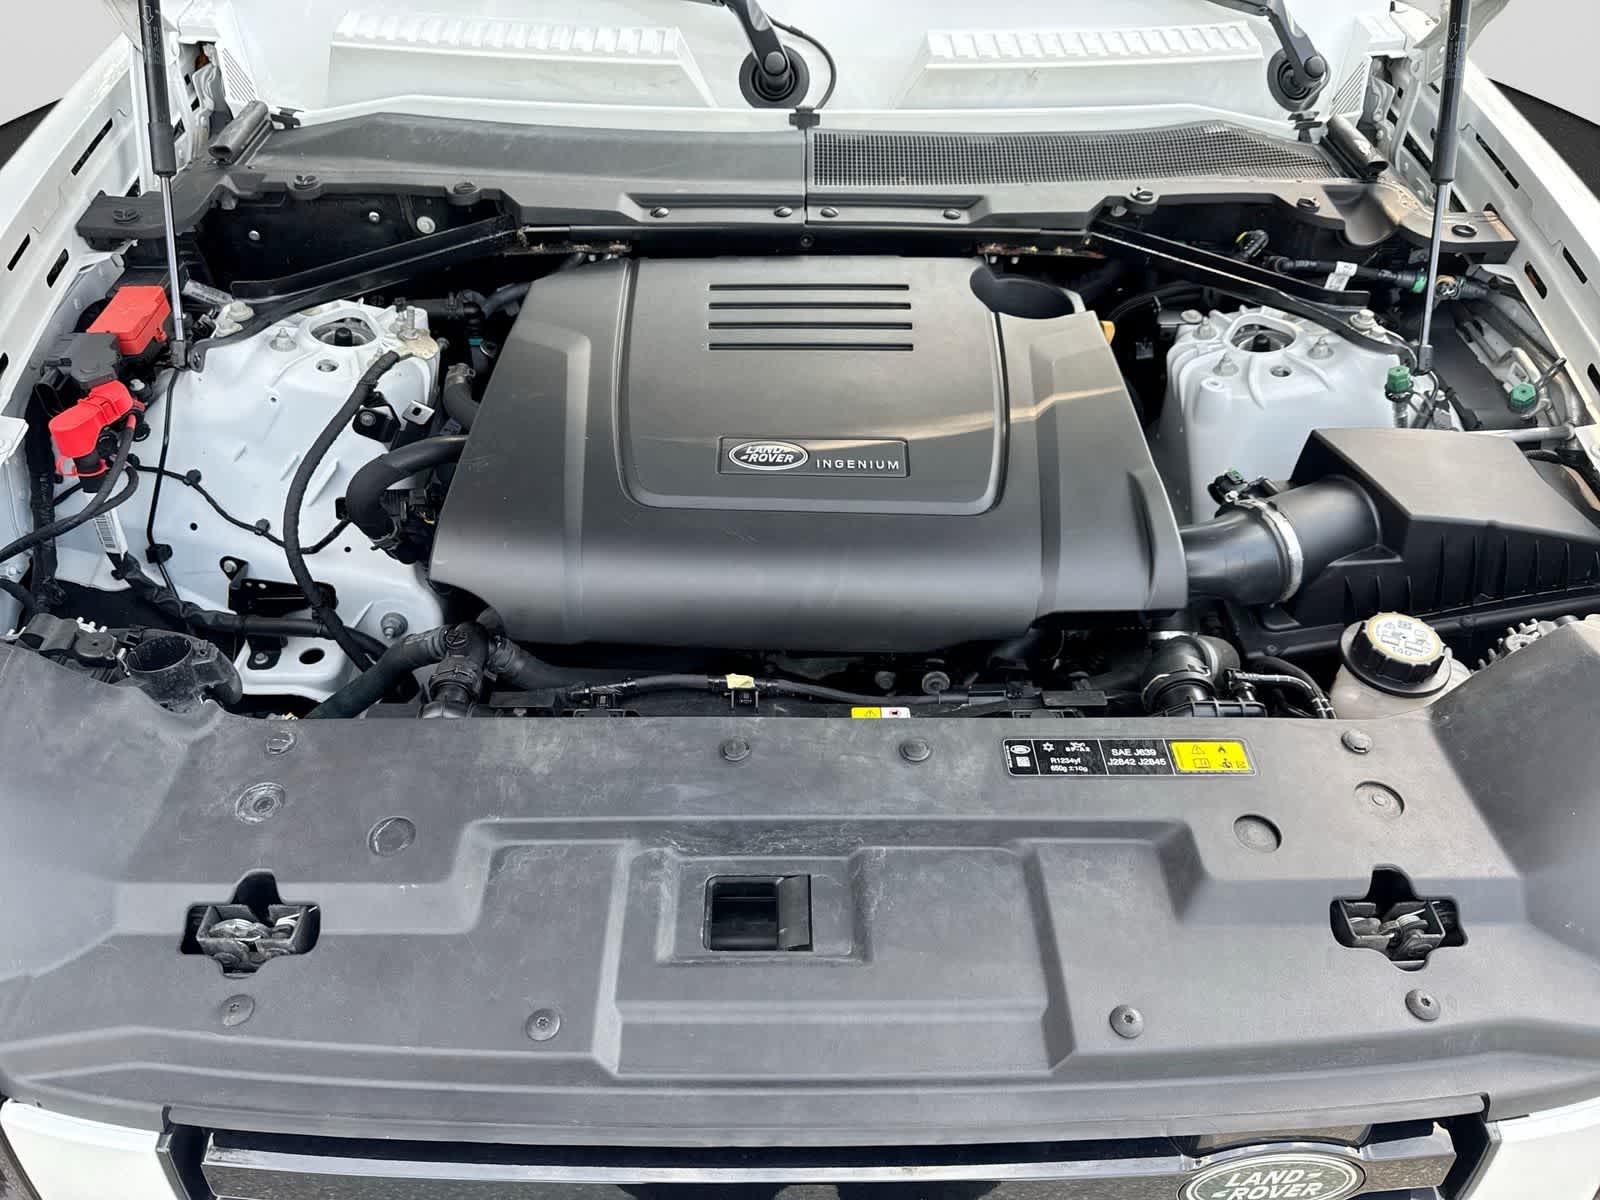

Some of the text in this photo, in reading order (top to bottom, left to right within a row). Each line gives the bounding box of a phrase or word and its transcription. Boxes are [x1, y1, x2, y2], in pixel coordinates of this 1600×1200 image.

[745, 446, 784, 454] LAND
[747, 453, 795, 463] ROVER
[816, 459, 900, 470] INGENIUM
[1111, 748, 1157, 756] SAE J639
[1107, 758, 1167, 766] J2842 J2845
[1224, 1169, 1306, 1188] LAND
[1226, 1183, 1324, 1200] ROVER
